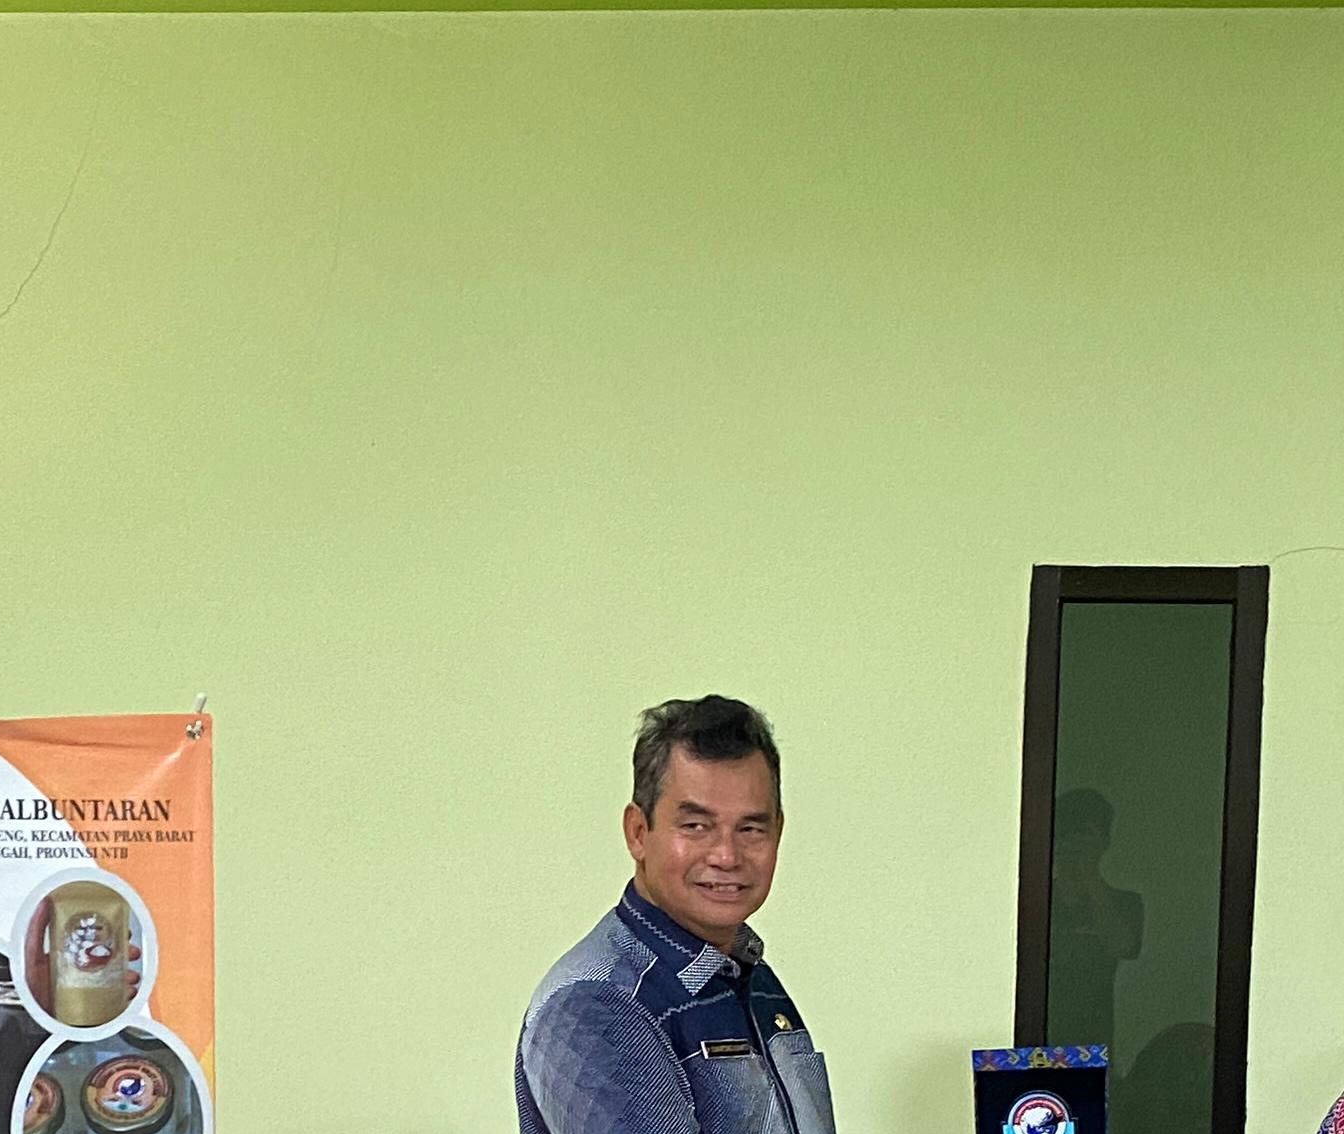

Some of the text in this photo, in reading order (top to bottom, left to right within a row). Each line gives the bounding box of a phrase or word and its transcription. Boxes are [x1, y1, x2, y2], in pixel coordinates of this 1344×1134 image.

[0, 798, 171, 821] ALBUNTARAN
[32, 830, 109, 843] KECAMATAN
[156, 830, 196, 843] BARAT
[36, 847, 98, 859] PROVINSI
[100, 847, 129, 859] NTB
